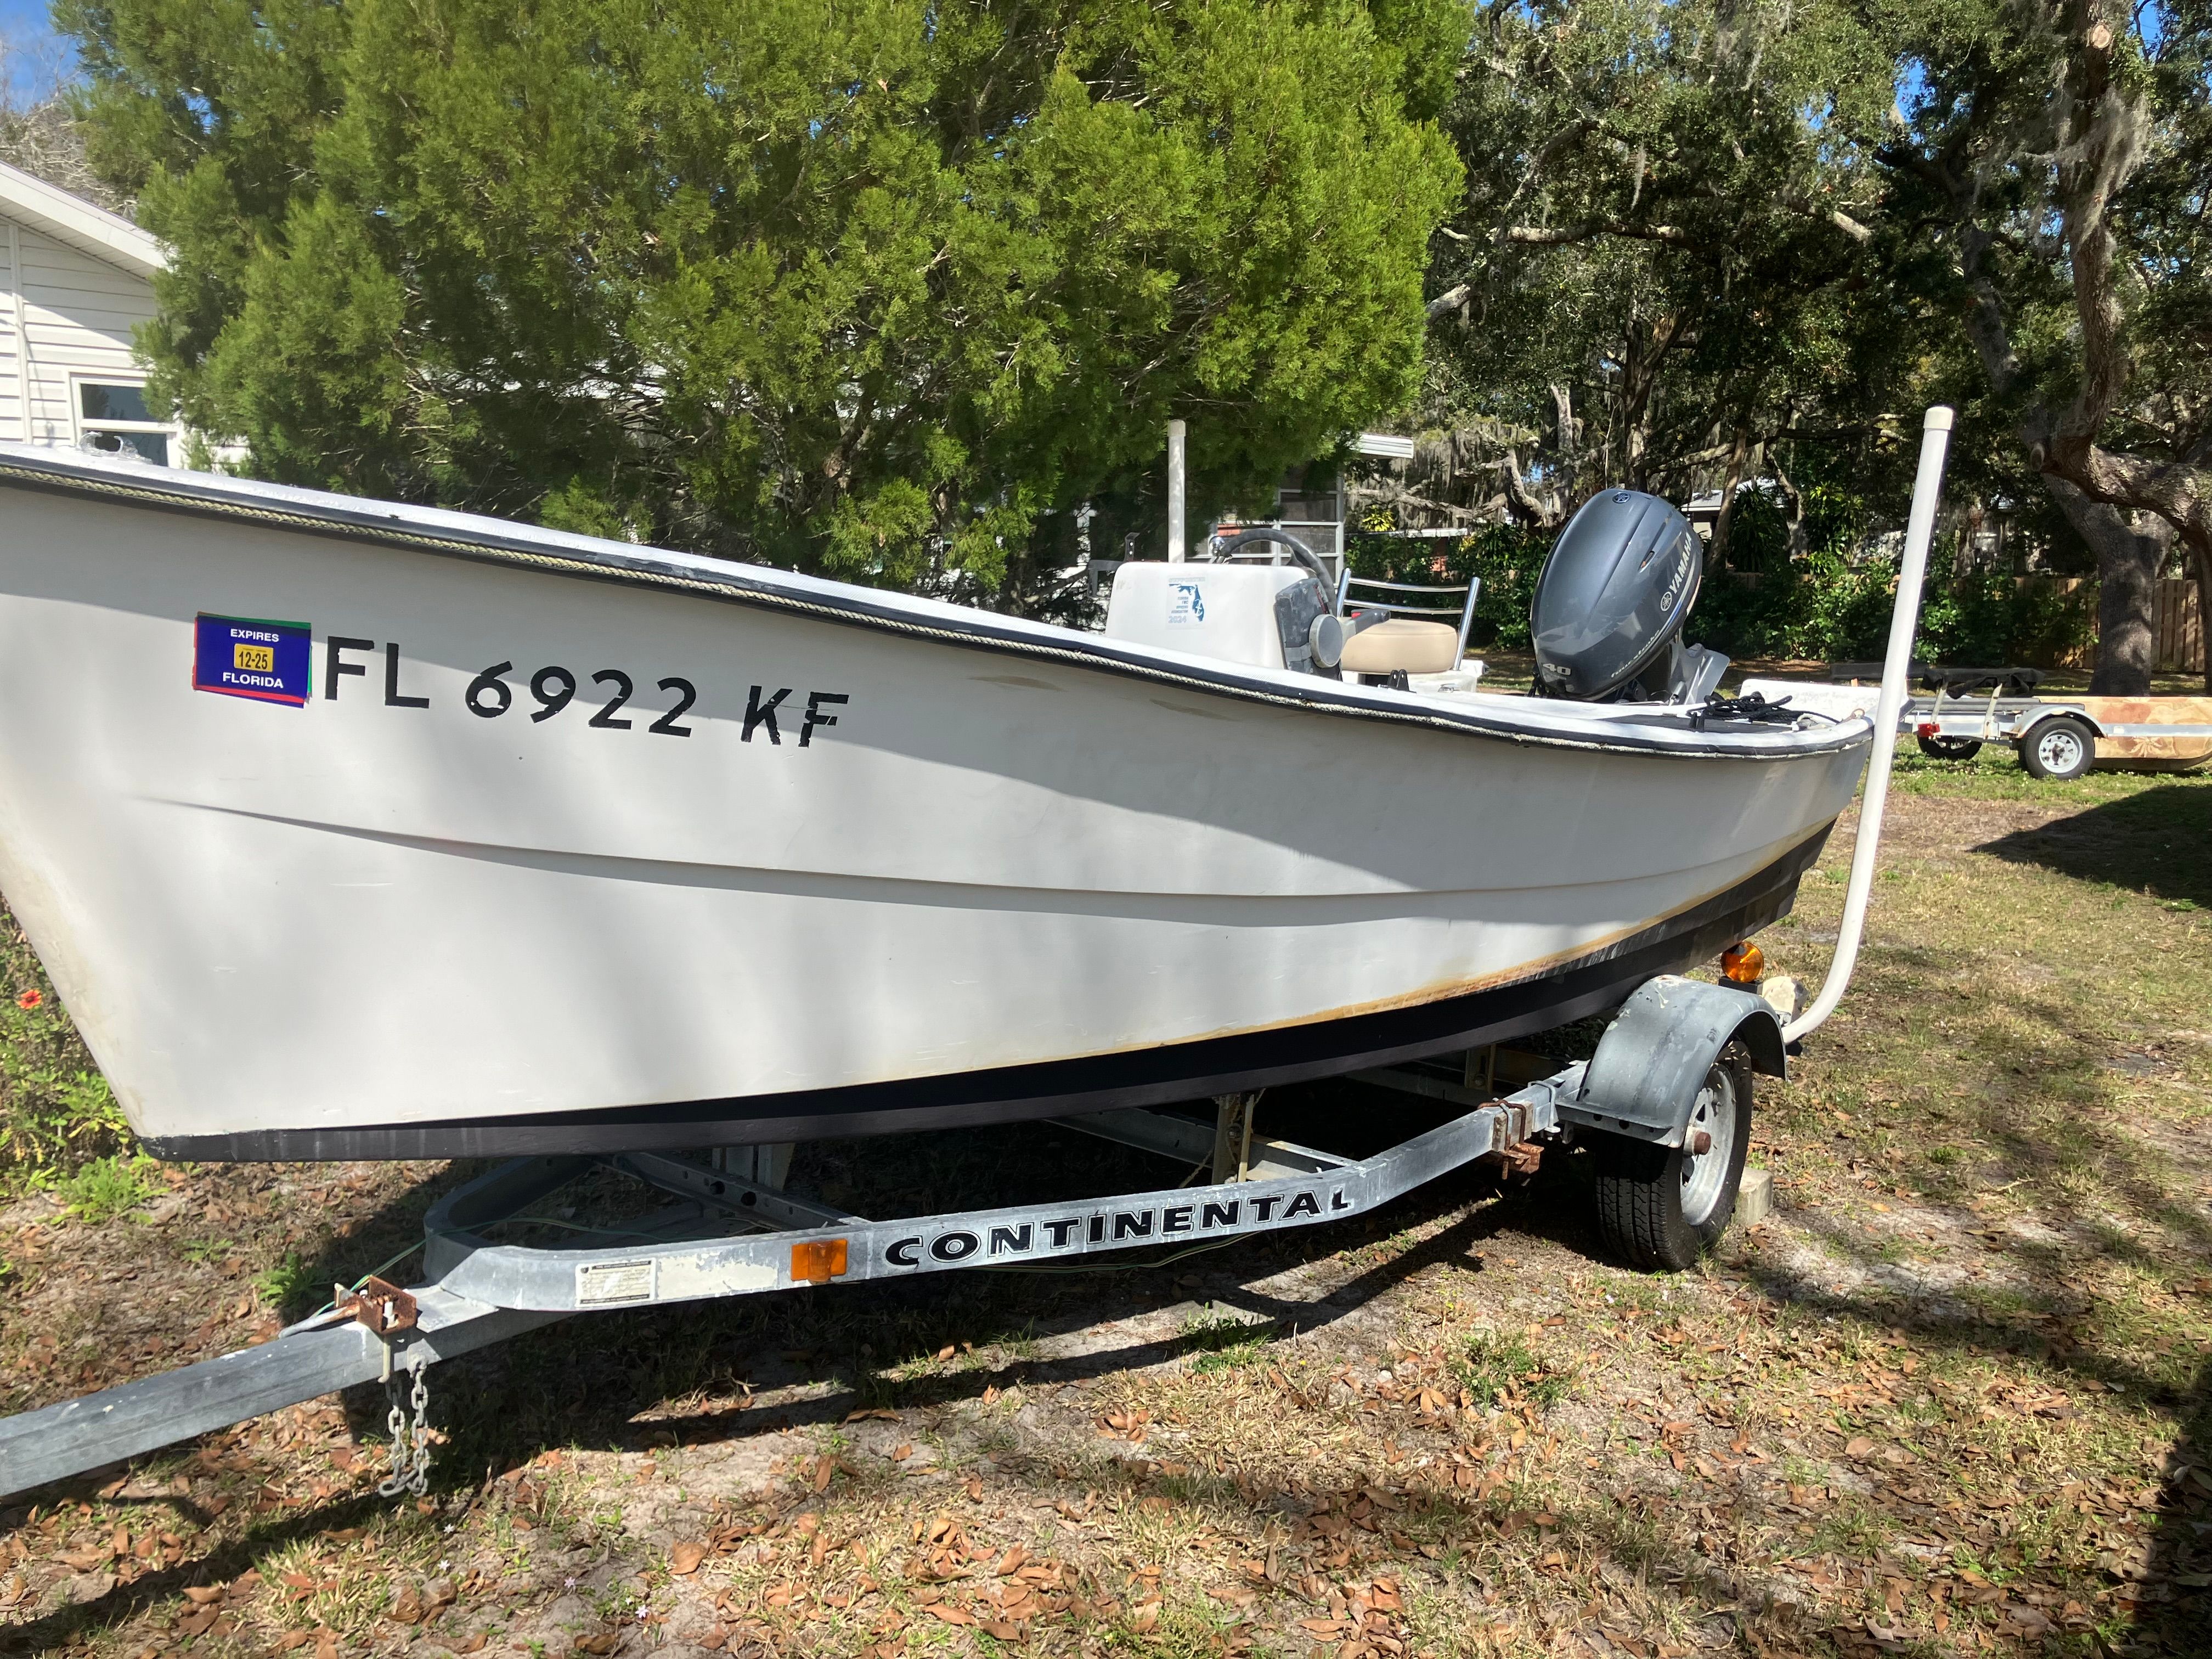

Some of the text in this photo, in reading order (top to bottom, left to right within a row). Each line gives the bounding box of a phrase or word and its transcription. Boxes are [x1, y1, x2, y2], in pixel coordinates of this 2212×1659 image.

[1669, 532, 1692, 594] YAMAHA
[230, 628, 280, 643] EXPIRES
[238, 651, 268, 670] 12-25
[1542, 663, 1571, 676] 40
[222, 672, 284, 689] FLORIDA
[325, 636, 850, 748] FL 6922 KF
[884, 1189, 1354, 1266] CONTINENTAL
